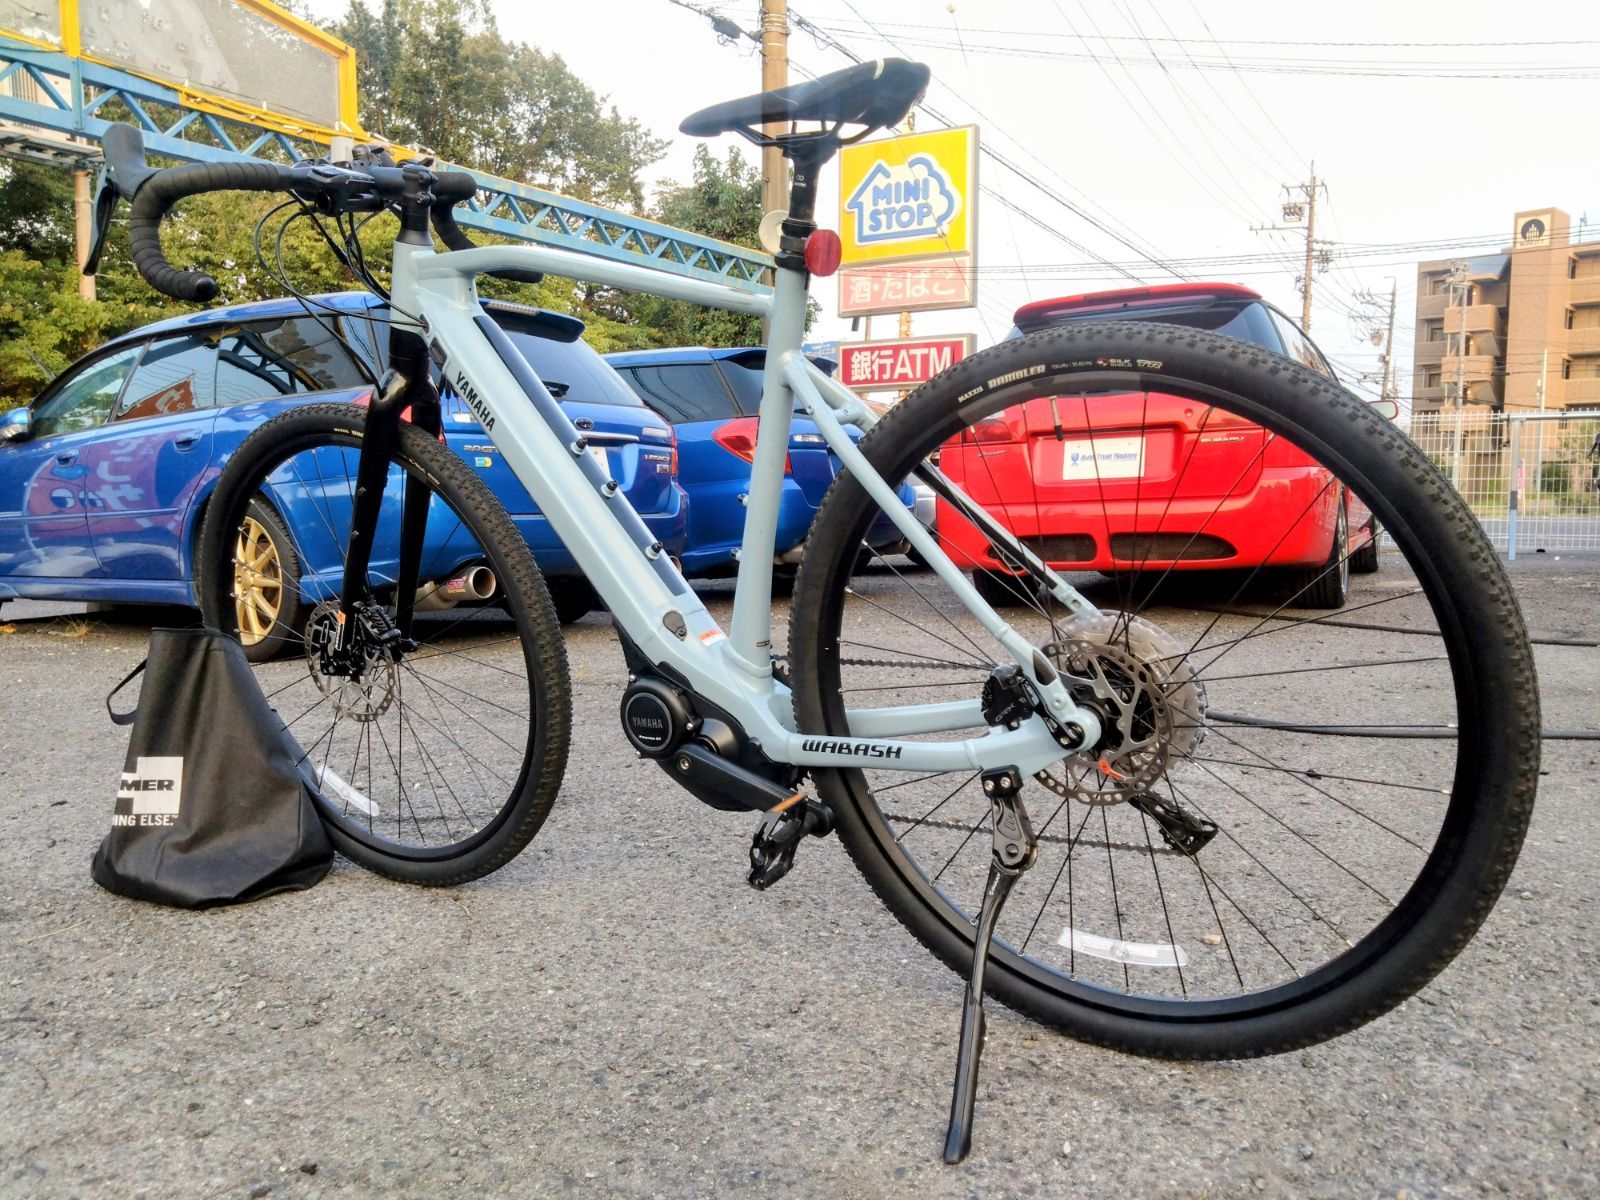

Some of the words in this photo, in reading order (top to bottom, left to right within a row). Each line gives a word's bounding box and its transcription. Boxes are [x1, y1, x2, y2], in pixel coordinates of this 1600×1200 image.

[872, 178, 930, 208] MINI
[868, 202, 933, 233] STOP
[849, 269, 957, 305] 酒・たばこ
[851, 346, 952, 383] 銀行ATM
[987, 364, 1047, 390] RAMBLER
[455, 371, 496, 432] YAMAHA
[632, 716, 664, 729] YAMAHA
[802, 739, 903, 759] WABASH
